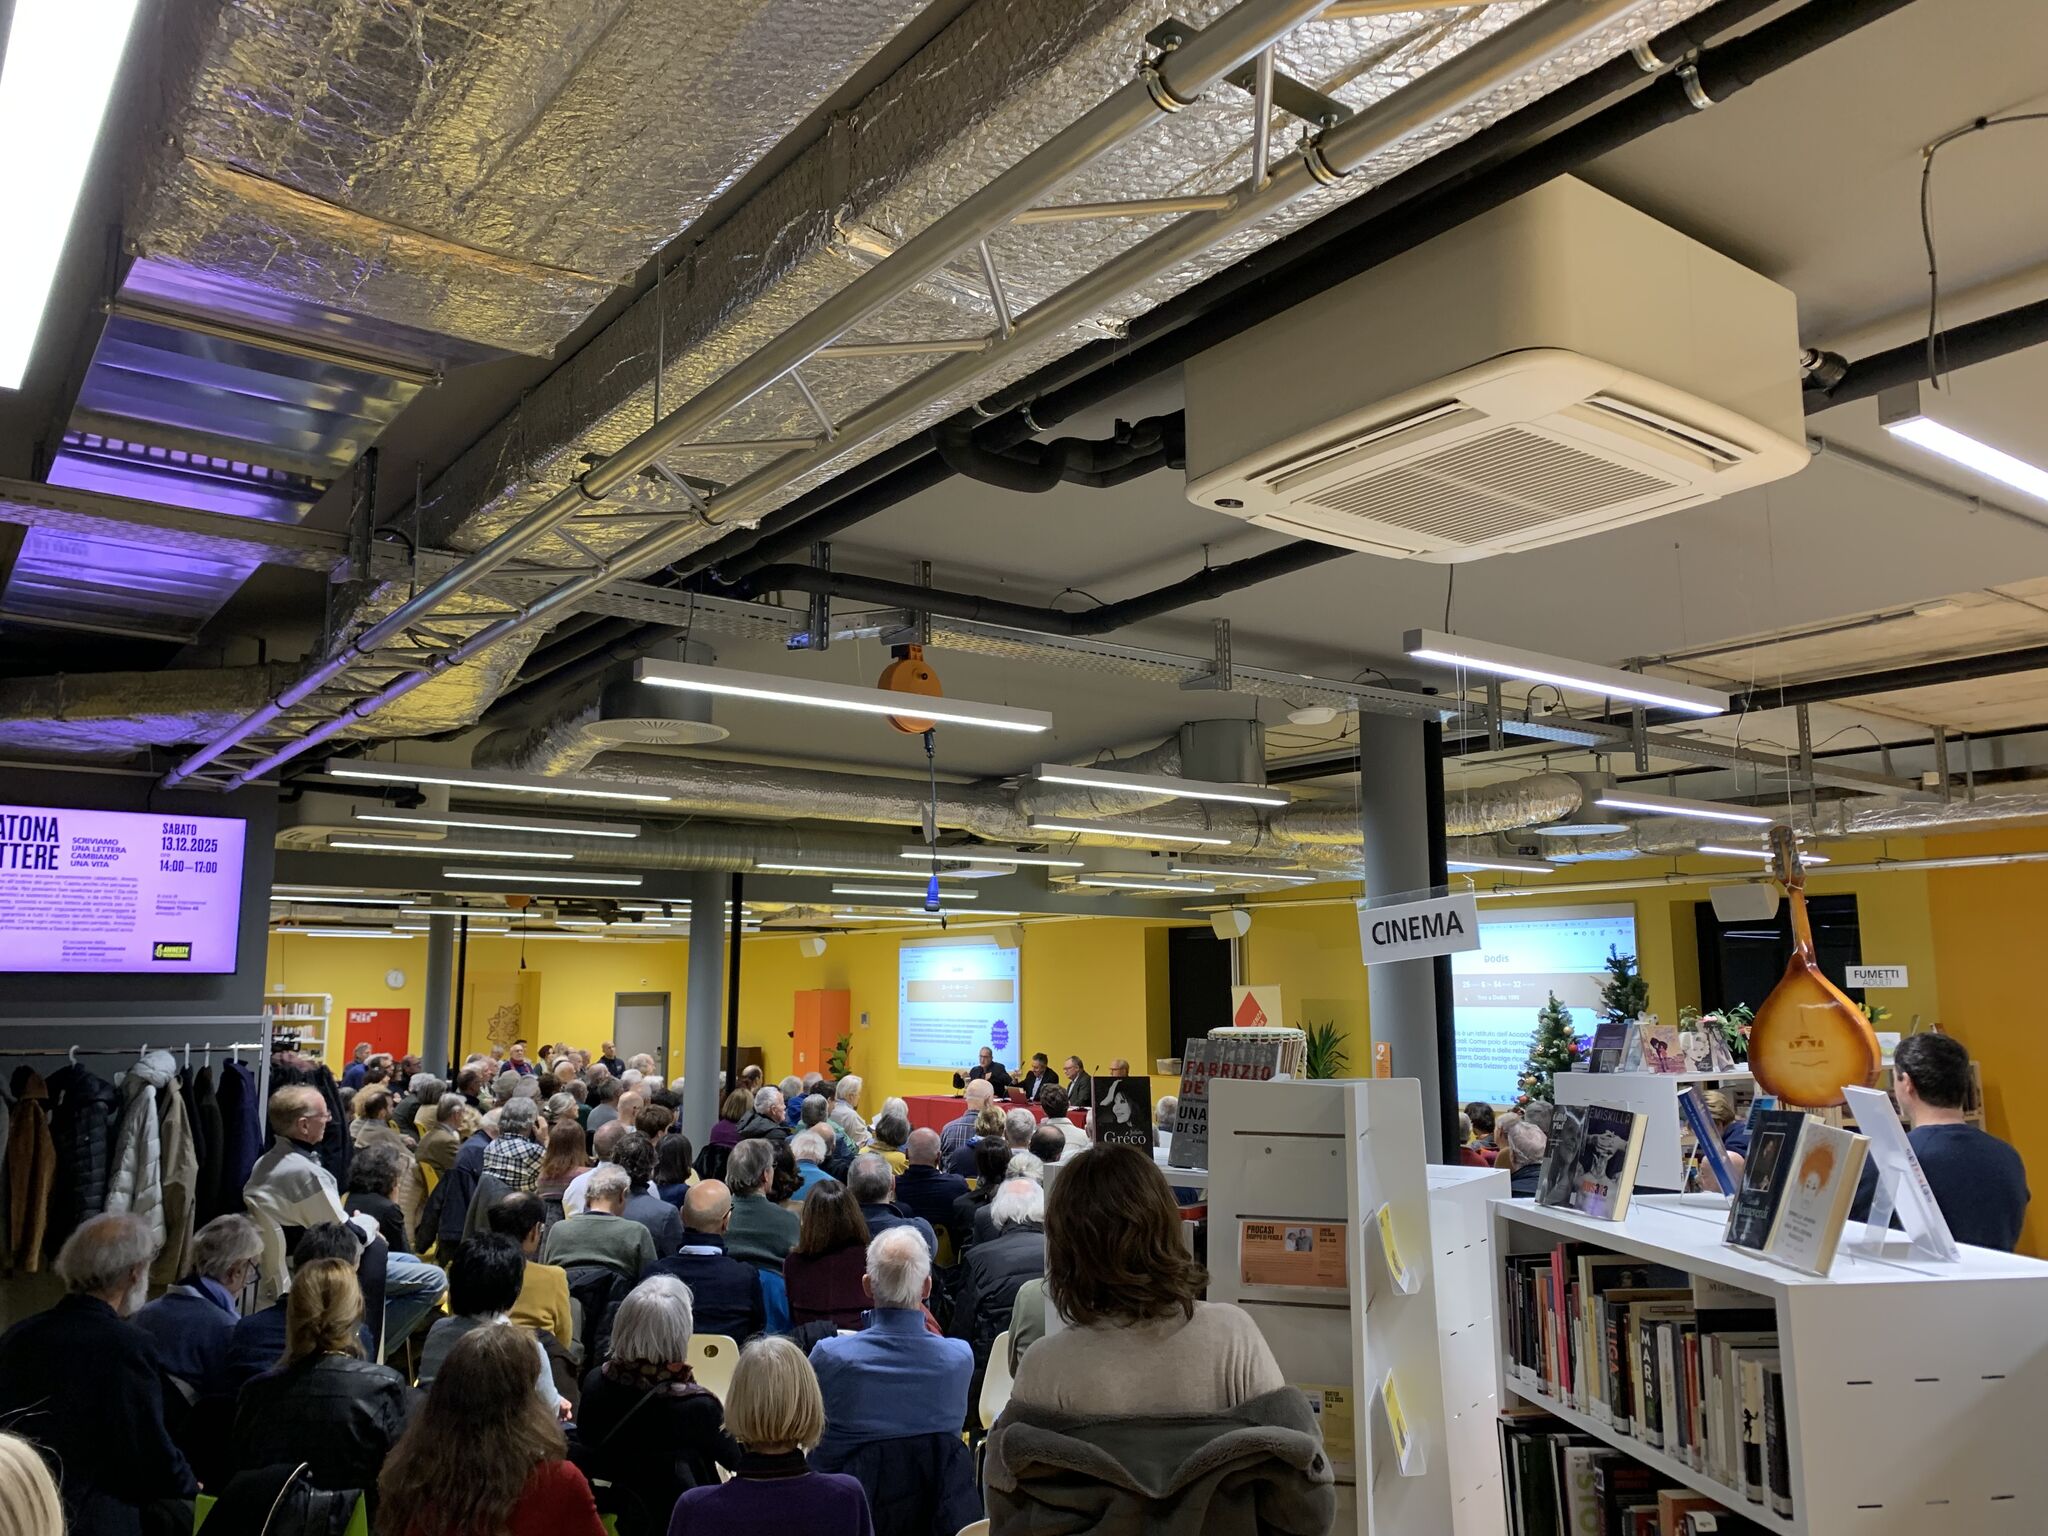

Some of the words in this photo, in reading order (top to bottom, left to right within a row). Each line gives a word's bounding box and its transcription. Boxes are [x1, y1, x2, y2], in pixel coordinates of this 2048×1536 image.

[162, 822, 197, 836] SABATO
[72, 837, 119, 846] SCRIVIAMO
[161, 836, 219, 853] 13.12.2025
[70, 853, 119, 861] CAMBIAMO
[92, 846, 127, 854] LETTERA
[1372, 910, 1464, 945] CINEMA
[1484, 953, 1510, 963] Dodis
[1854, 969, 1900, 979] FUMETTI
[1185, 1061, 1272, 1081] FABRIZIO
[1183, 1080, 1205, 1095] DE
[1179, 1106, 1207, 1120] UNA
[1176, 1122, 1189, 1133] DI
[1103, 1131, 1147, 1145] Gréco
[1246, 1225, 1275, 1235] PROCASI
[1641, 1329, 1653, 1398] MARR
